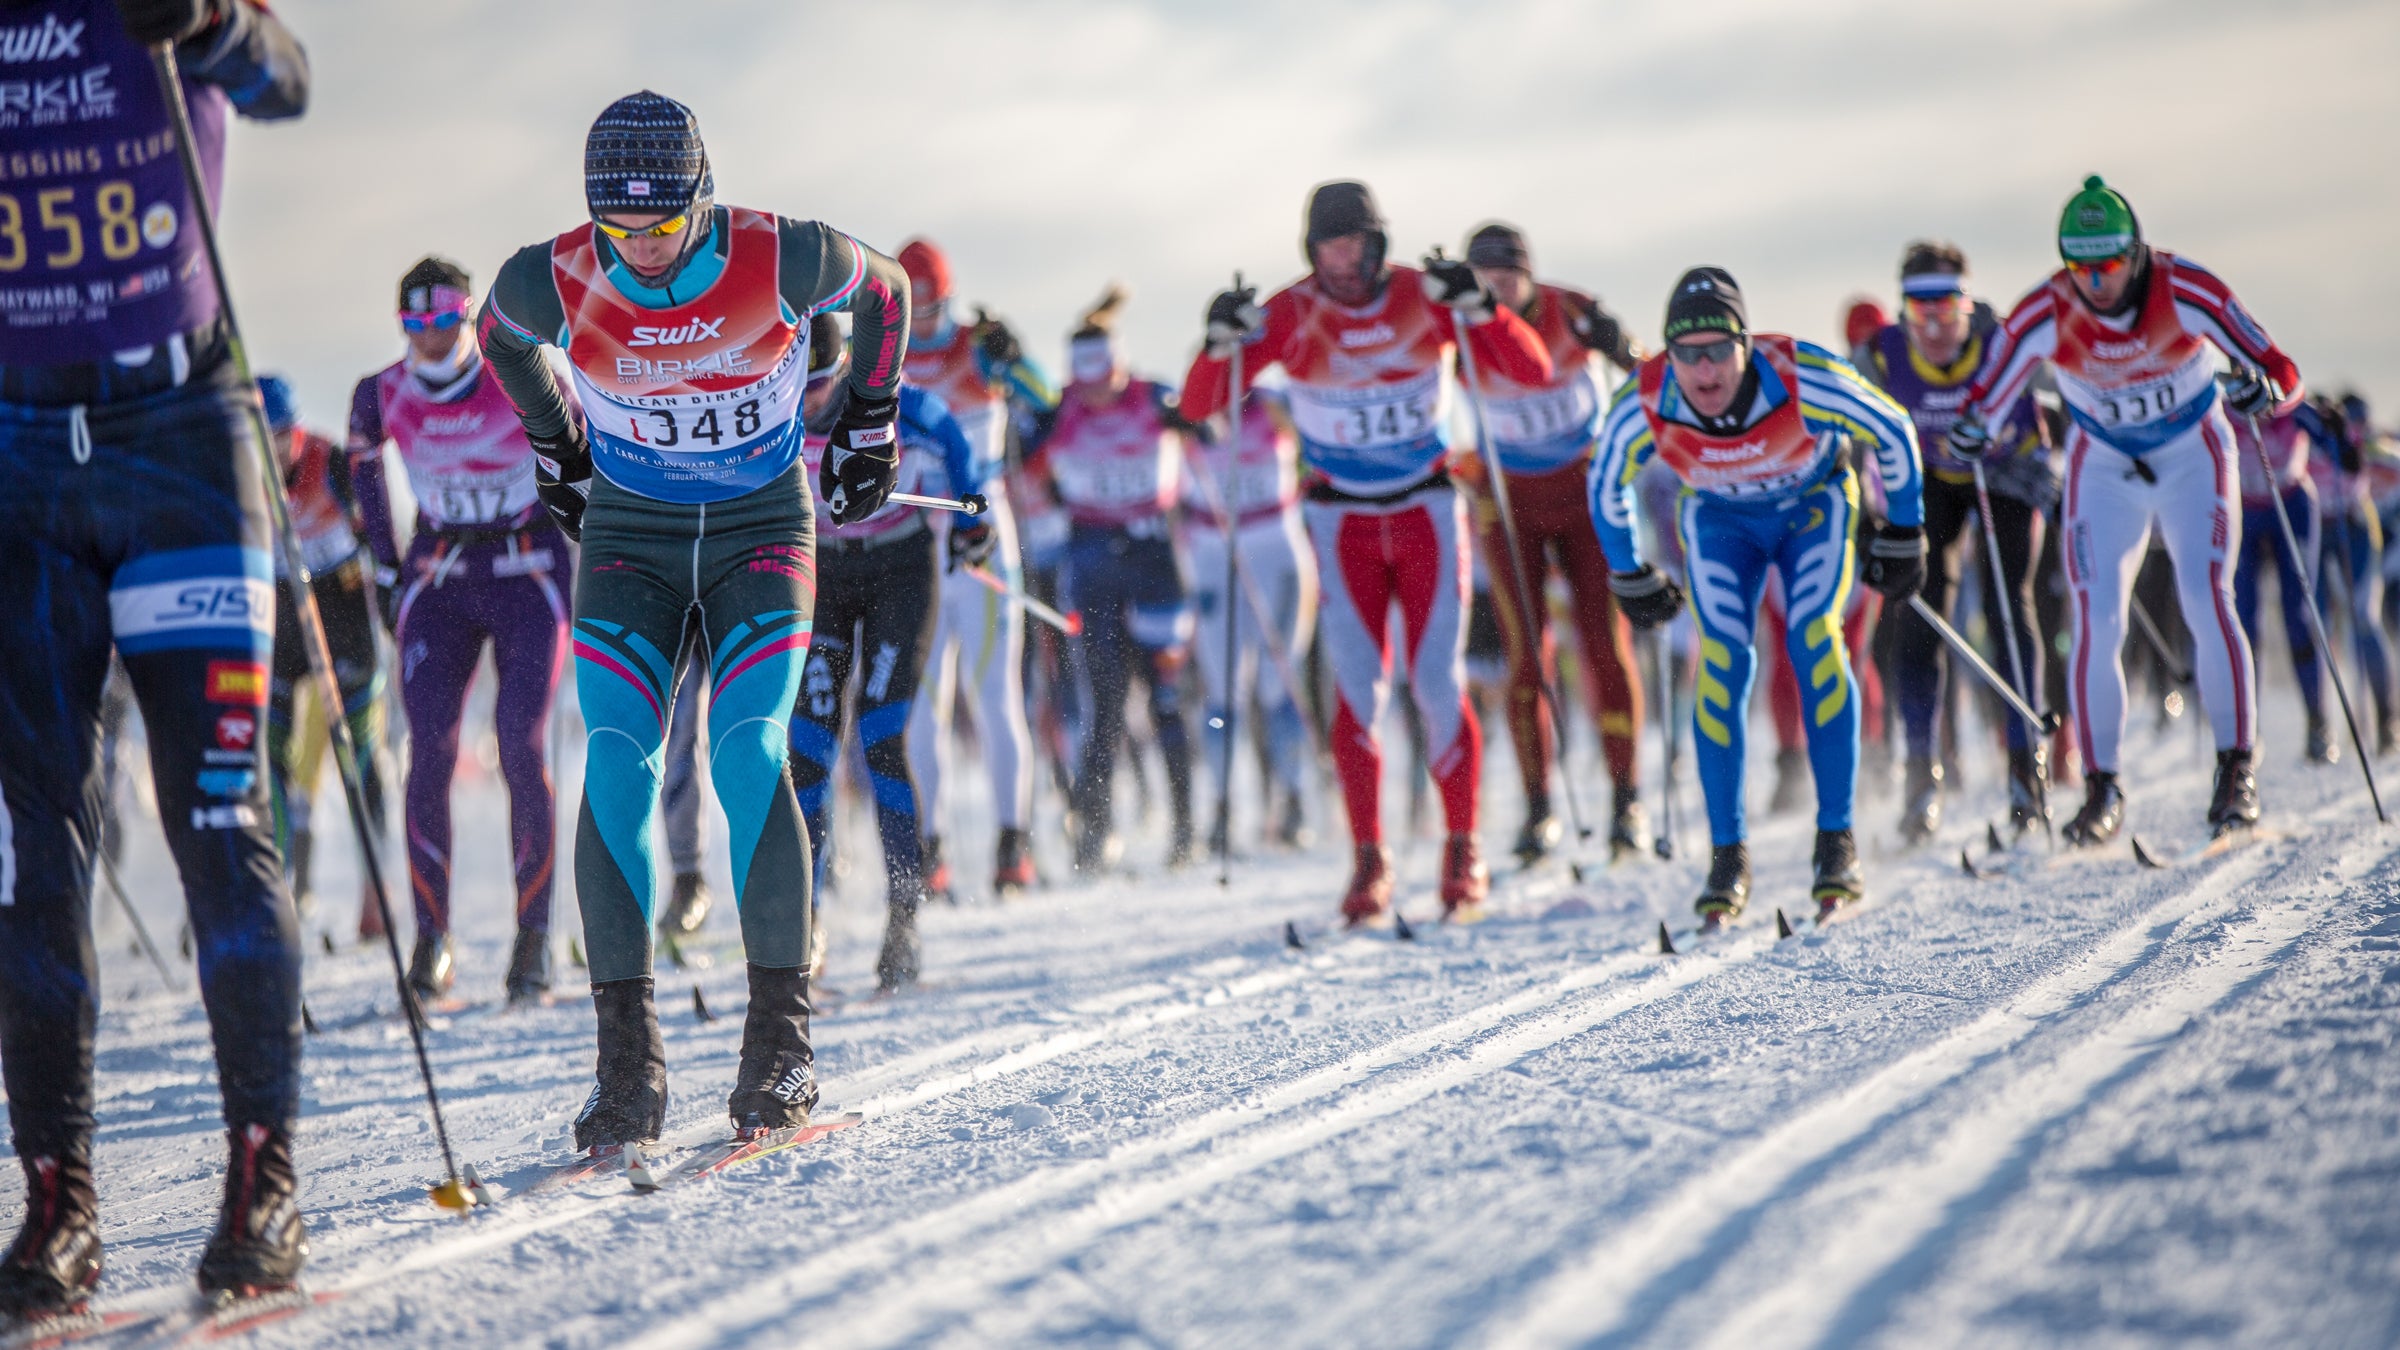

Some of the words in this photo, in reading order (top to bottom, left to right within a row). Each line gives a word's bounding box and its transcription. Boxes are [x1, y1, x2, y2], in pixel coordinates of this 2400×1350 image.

[0, 13, 84, 62] wix
[0, 65, 116, 110] RKIE
[0, 180, 140, 272] 358
[615, 344, 752, 378] BIRKIE
[724, 365, 752, 378] LIVE
[649, 399, 761, 447] 348
[664, 471, 698, 481] FEBRUARY
[720, 467, 736, 479] 2014
[724, 454, 741, 466] WI
